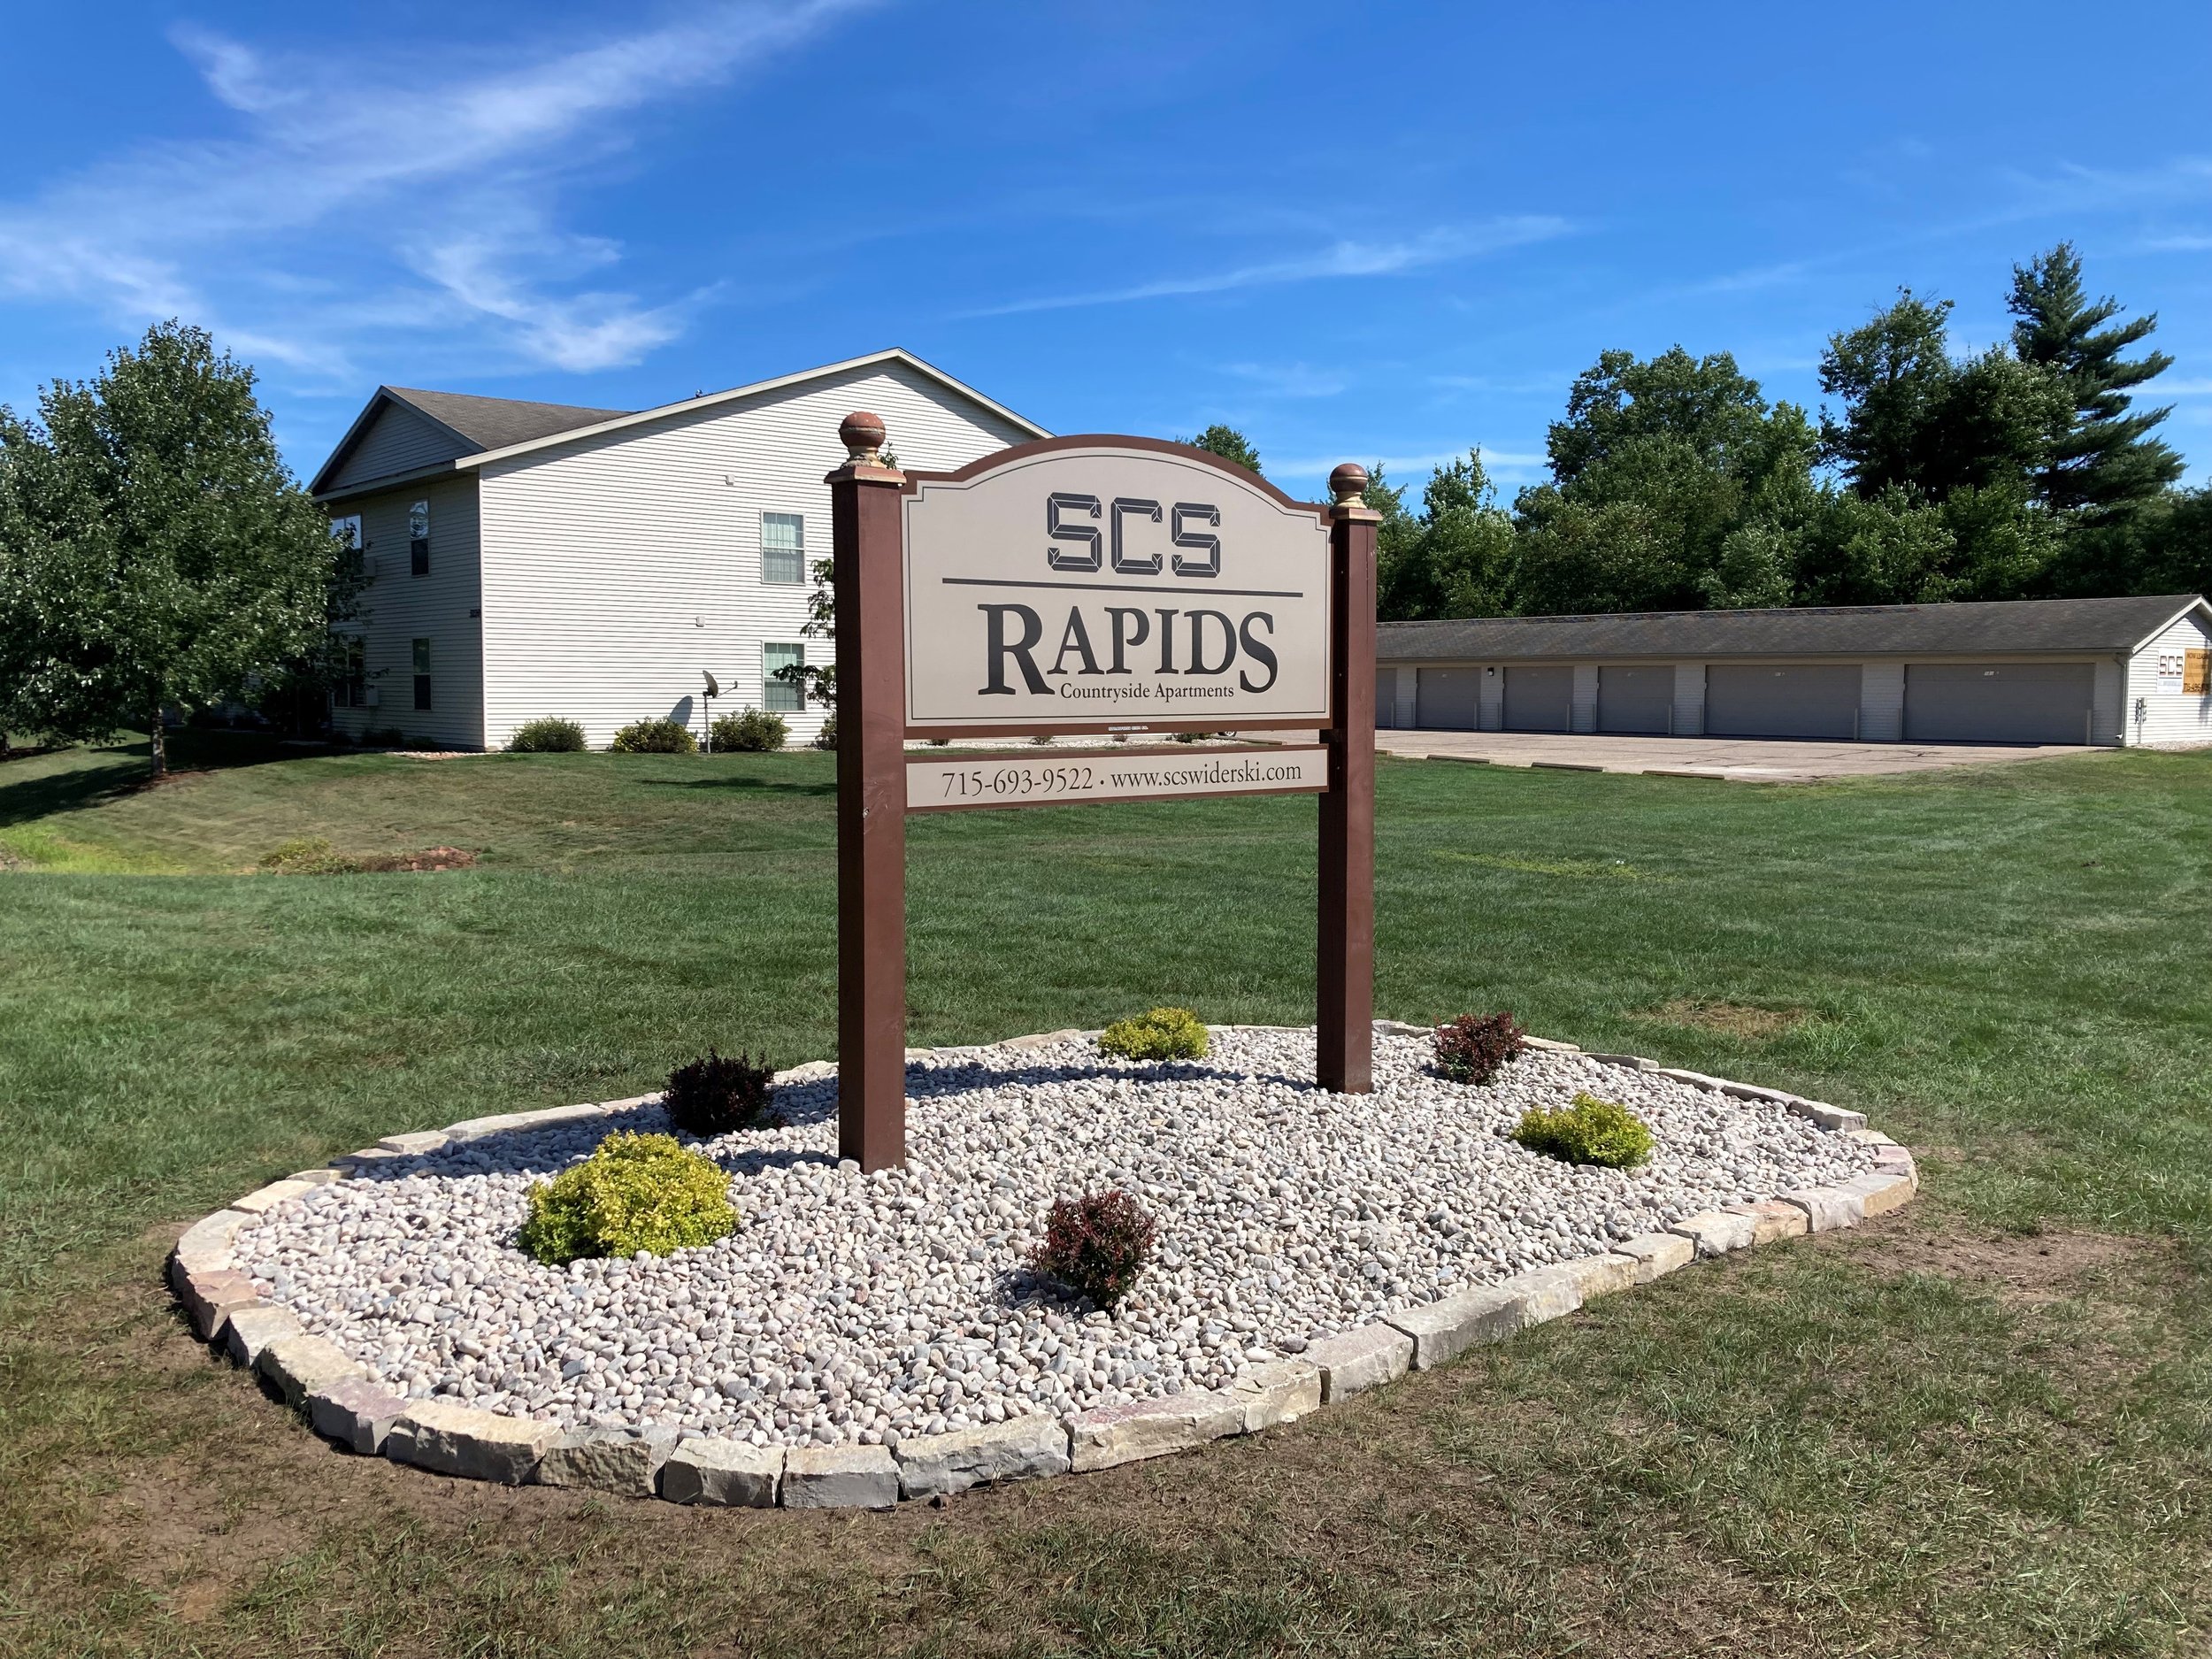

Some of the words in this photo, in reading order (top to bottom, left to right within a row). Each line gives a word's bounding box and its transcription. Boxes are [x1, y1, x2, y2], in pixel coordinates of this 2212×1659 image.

[1048, 492, 1220, 578] SCS
[978, 604, 1278, 695] RAPIDS
[2159, 656, 2183, 675] SCS
[1060, 683, 1150, 703] Countryside
[1154, 682, 1234, 703] Apartments
[941, 767, 1093, 797] 715-693-9522
[1110, 760, 1302, 790] www.scswiderski.com
